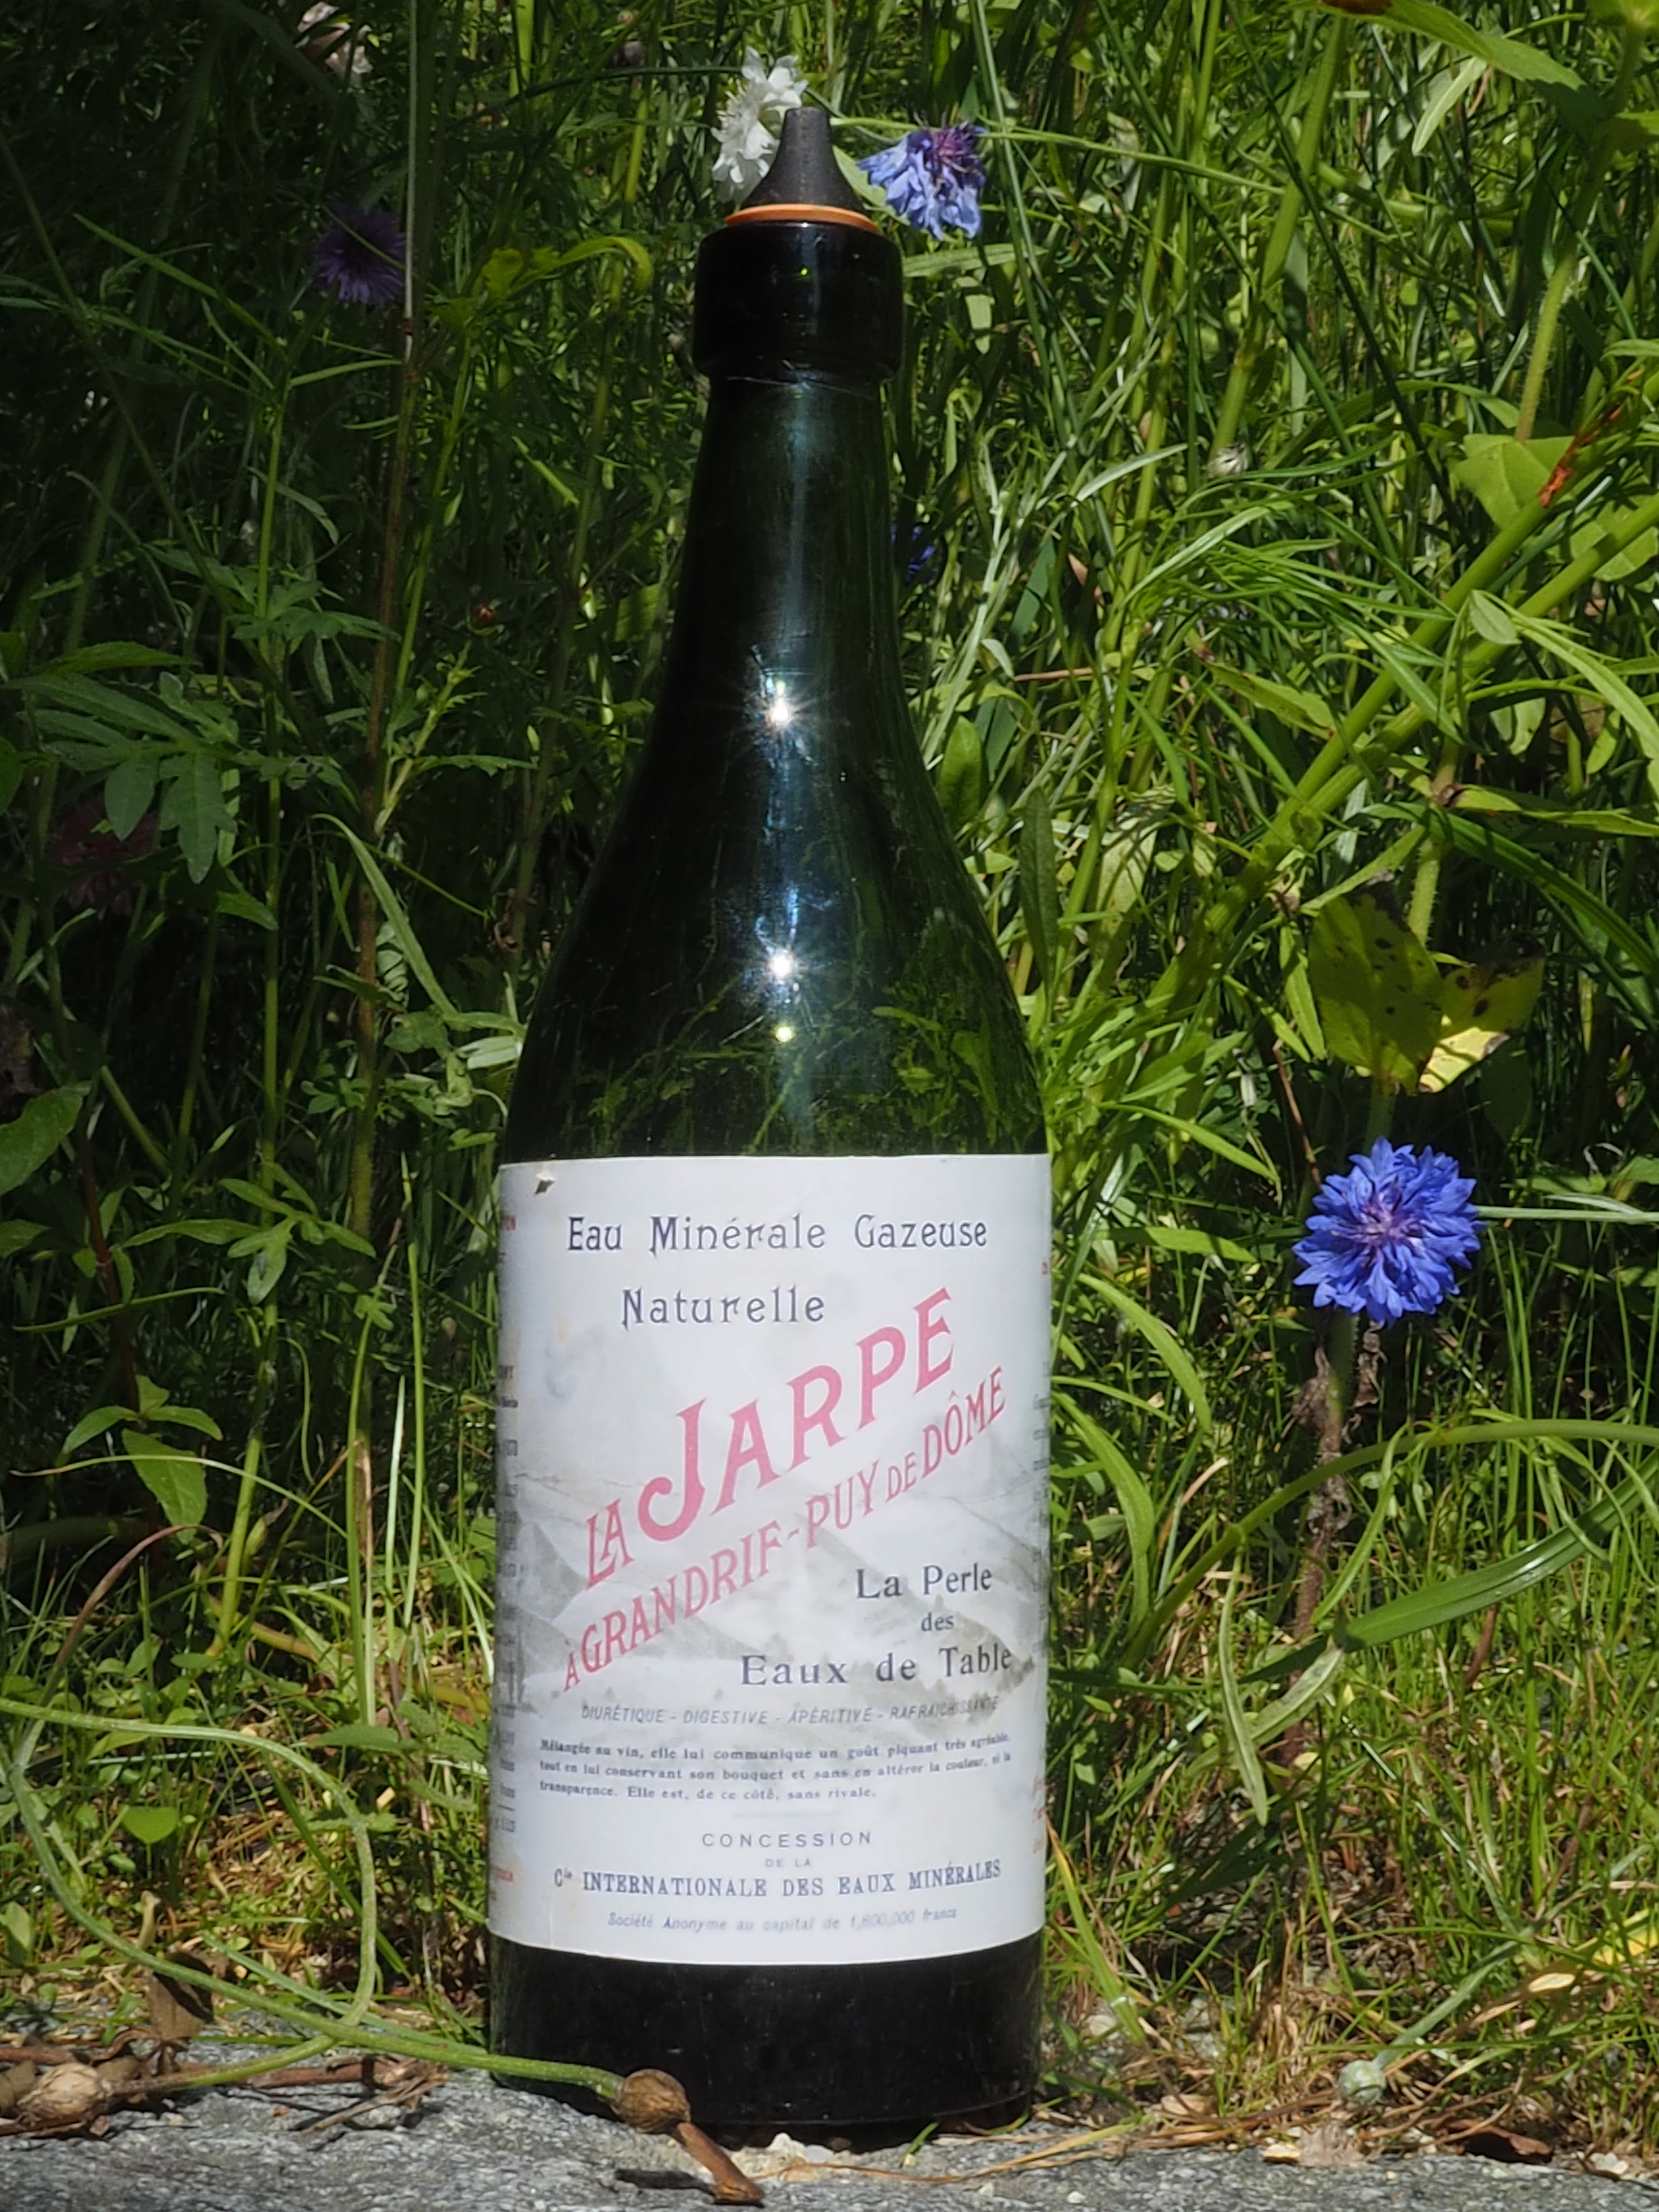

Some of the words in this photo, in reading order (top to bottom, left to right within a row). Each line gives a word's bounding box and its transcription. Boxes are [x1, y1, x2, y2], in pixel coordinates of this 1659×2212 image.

[567, 1216, 622, 1251] Eau
[649, 1213, 827, 1257] Minérale
[854, 1214, 988, 1248] Gazeuse
[621, 1284, 826, 1331] Naturelle
[585, 1498, 635, 1590] LA
[637, 1287, 954, 1541] JARPE
[886, 1451, 917, 1503] DE
[921, 1366, 1006, 1479] DÔME
[856, 1568, 903, 1599] La
[922, 1562, 993, 1595] Perle
[921, 1611, 954, 1632] des
[741, 1654, 849, 1685] Eaux
[876, 1652, 916, 1681] de
[939, 1643, 1012, 1678] Table
[581, 1704, 665, 1723] DIURÉTIQUE
[683, 1709, 769, 1724] DIGESTIVE
[596, 1745, 612, 1755] au
[650, 1748, 677, 1759] elle
[684, 1748, 704, 1759] lui
[713, 1749, 813, 1764] communique
[819, 1750, 838, 1759] un
[847, 1744, 879, 1760] goût
[888, 1742, 938, 1758] piquant
[539, 1760, 561, 1771] tout
[564, 1764, 578, 1773] en
[584, 1764, 600, 1775] lui
[605, 1766, 682, 1779] conservant
[689, 1770, 715, 1779] son
[722, 1768, 784, 1782] bouquet
[791, 1769, 806, 1779] et
[814, 1770, 849, 1779] sans
[854, 1767, 871, 1778] en
[878, 1765, 924, 1777] altérer
[929, 1761, 941, 1773] la
[627, 1786, 656, 1798] Elle
[697, 1789, 714, 1800] de
[721, 1791, 736, 1800] ce
[787, 1791, 820, 1800] sans
[702, 1831, 872, 1849] CONCESSION
[765, 1859, 784, 1868] DE
[795, 1858, 812, 1867] LA
[582, 1872, 768, 1897] INTERNATIONALE
[782, 1879, 824, 1897] DES
[839, 1873, 895, 1895] EAUX
[908, 1859, 1001, 1890] MINÉRALES
[608, 1911, 653, 1929] Société
[662, 1915, 726, 1933] Anonyme
[737, 1920, 753, 1930] au
[763, 1918, 814, 1933] capital
[823, 1919, 840, 1930] de
